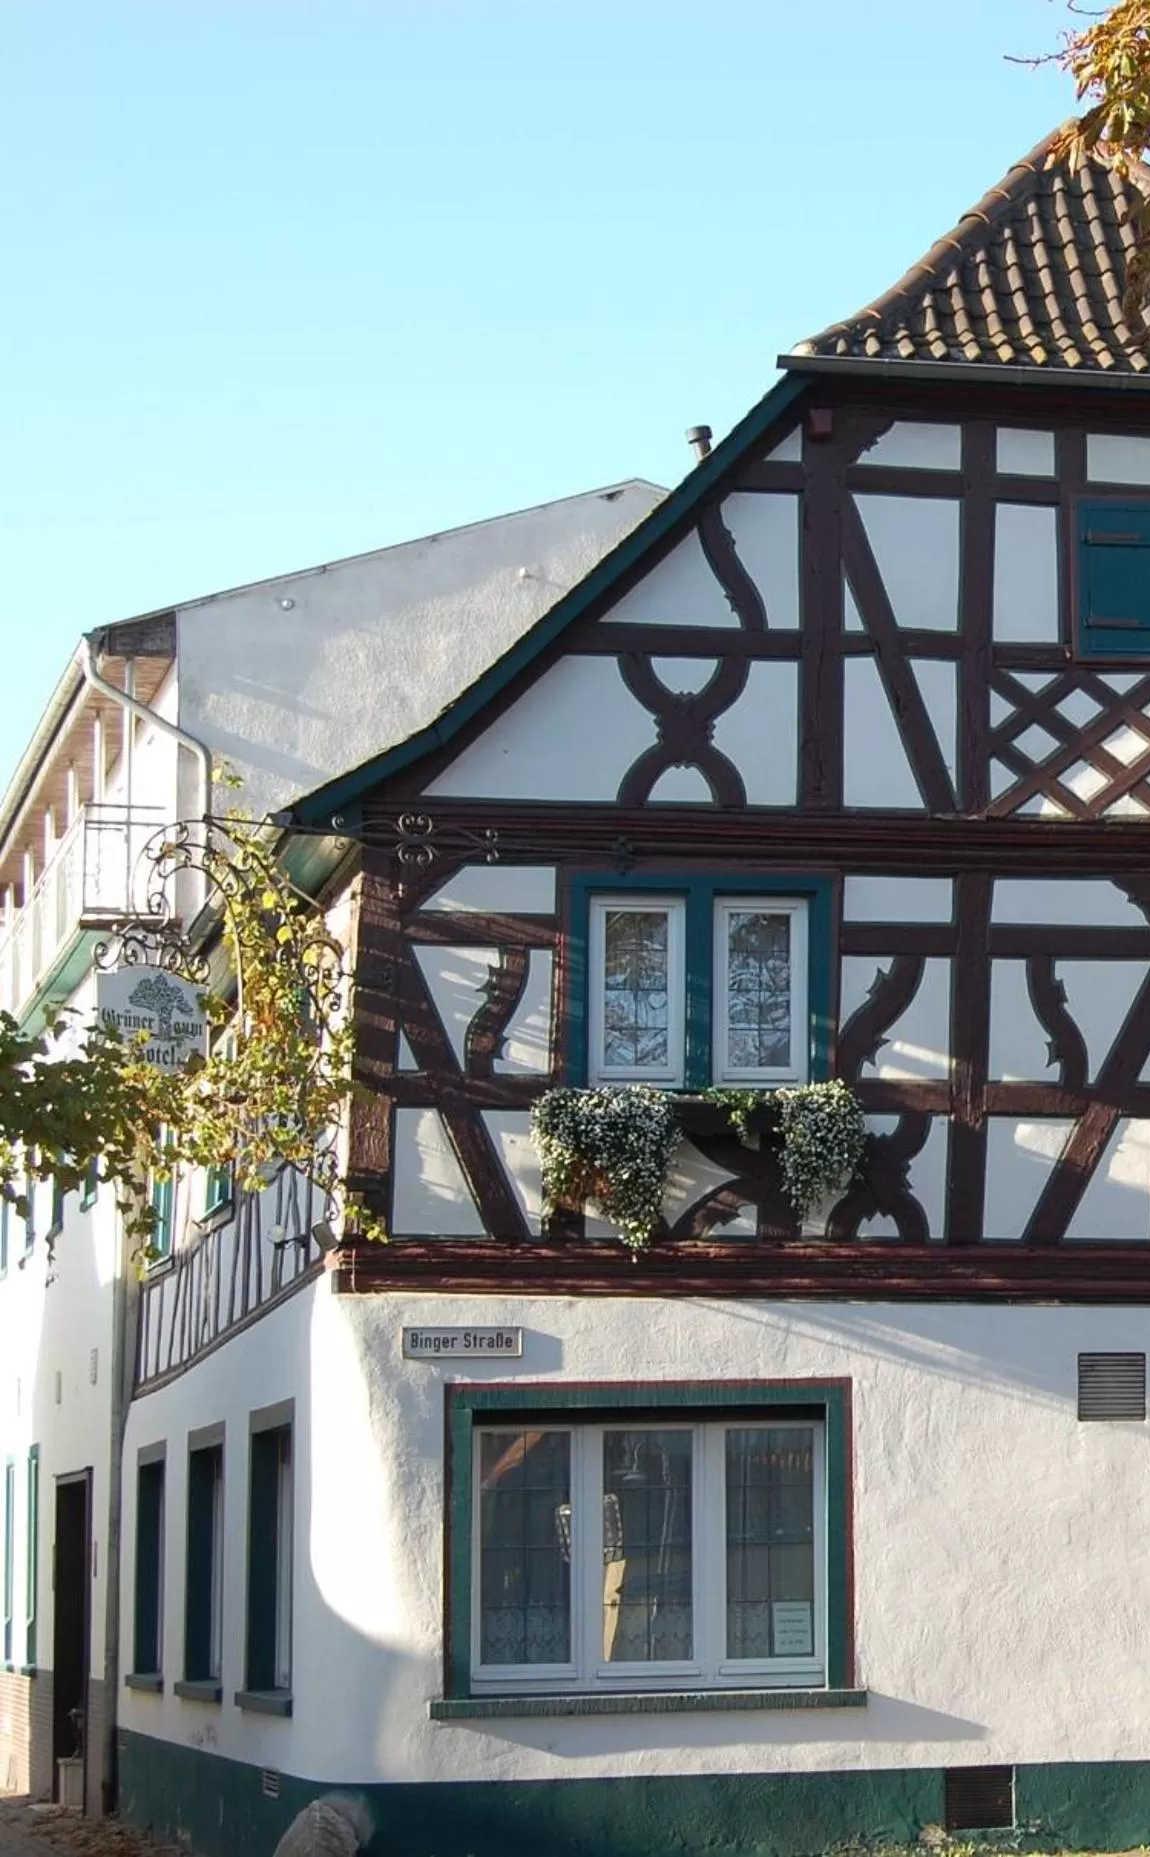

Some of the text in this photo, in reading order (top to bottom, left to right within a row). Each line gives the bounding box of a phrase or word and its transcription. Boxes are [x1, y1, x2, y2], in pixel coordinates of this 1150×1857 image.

[140, 1045, 175, 1066] otel
[410, 1331, 513, 1352] Binger Straße
